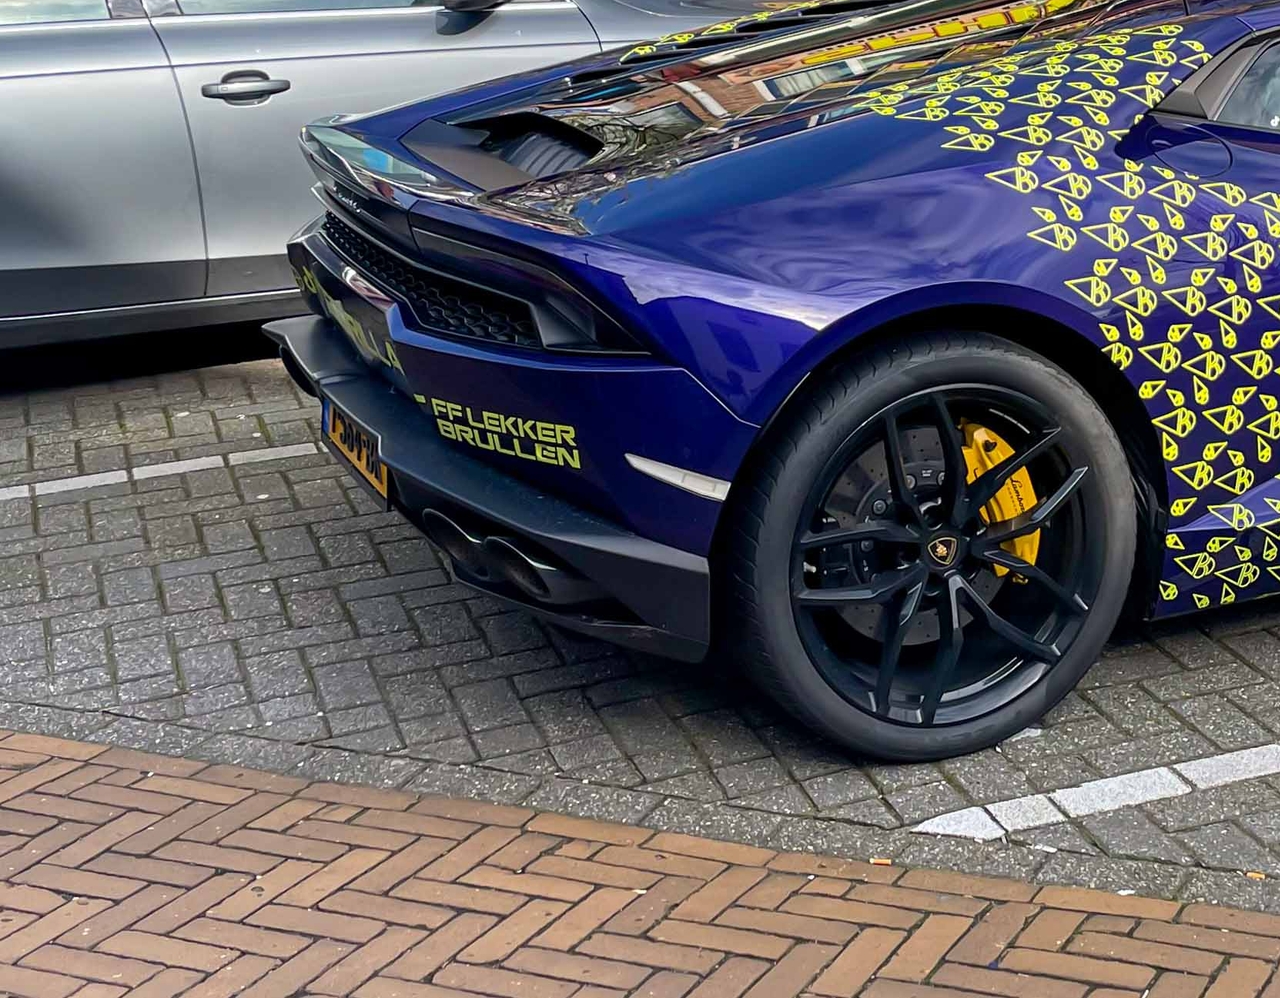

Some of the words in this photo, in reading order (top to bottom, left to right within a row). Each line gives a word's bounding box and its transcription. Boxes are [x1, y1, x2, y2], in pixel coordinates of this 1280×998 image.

[430, 397, 463, 421] FF
[465, 406, 577, 447] LEKKER
[436, 418, 582, 470] BRULLEN
